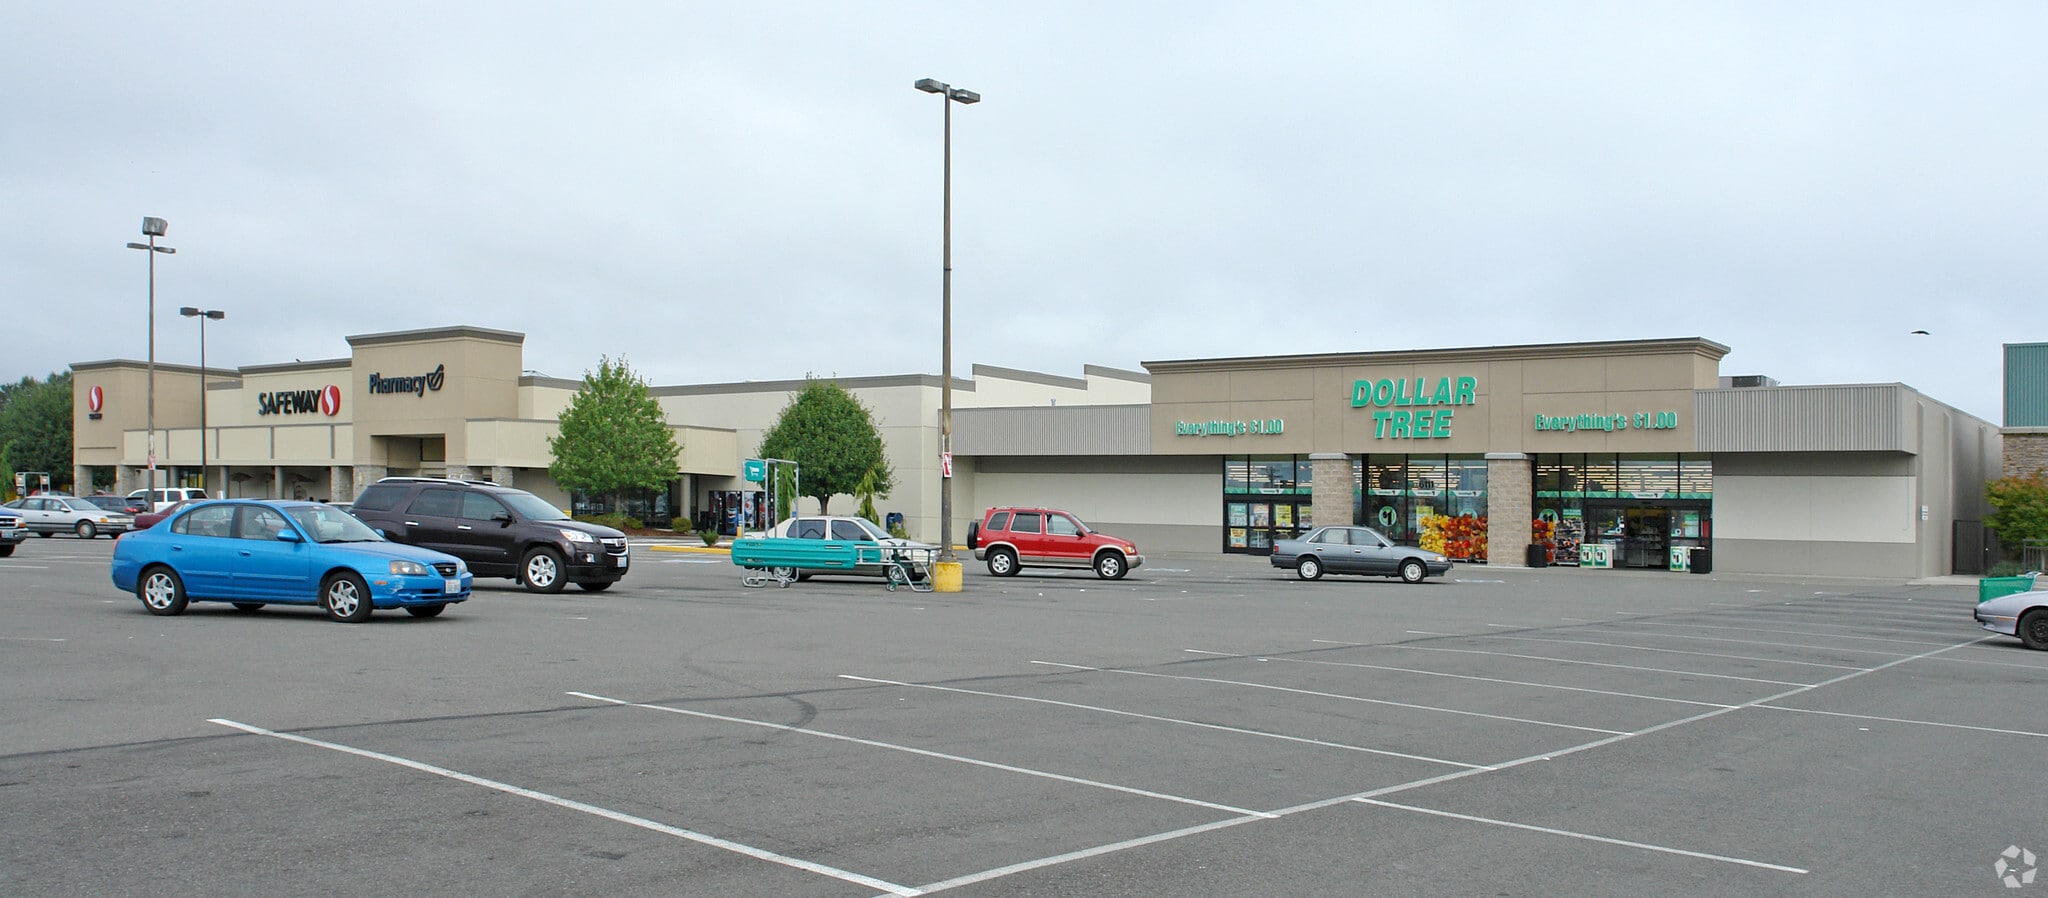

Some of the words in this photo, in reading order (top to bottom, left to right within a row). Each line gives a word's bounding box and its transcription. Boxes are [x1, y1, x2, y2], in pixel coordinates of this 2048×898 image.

[369, 373, 425, 398] Pharmacy
[1351, 376, 1477, 408] DOLLAR
[258, 389, 321, 416] SAFEWAY
[1175, 419, 1247, 436] Everything's
[1249, 418, 1284, 434] $1.00
[1372, 409, 1454, 439] TREE
[1535, 412, 1627, 432] Everything's
[1633, 411, 1677, 429] $1.00
